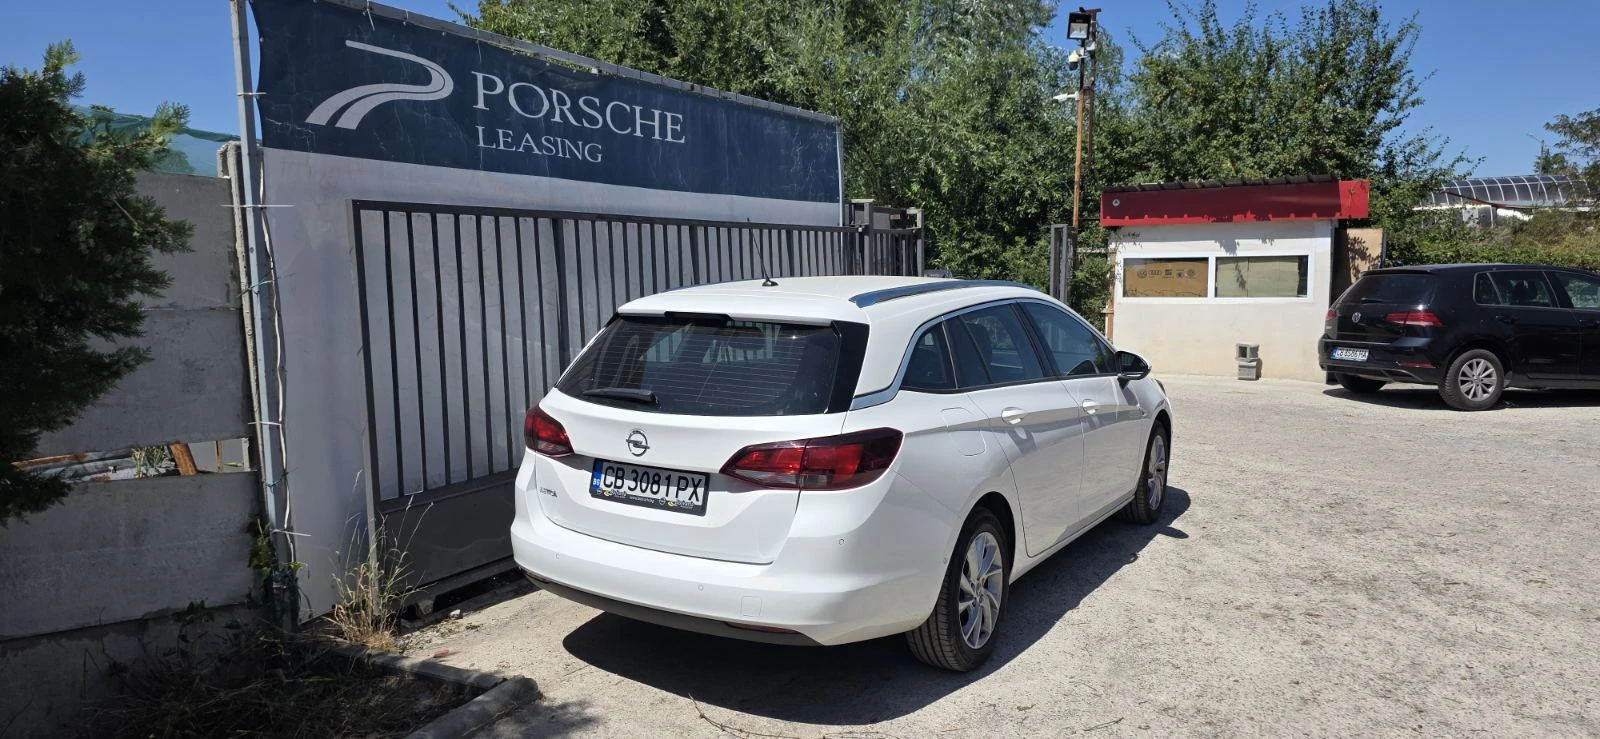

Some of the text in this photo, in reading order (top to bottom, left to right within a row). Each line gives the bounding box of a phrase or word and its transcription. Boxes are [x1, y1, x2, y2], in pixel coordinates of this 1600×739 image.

[471, 71, 686, 144] PORSCHE
[475, 125, 602, 162] LEASING
[603, 466, 702, 502] CB 3081 PX
